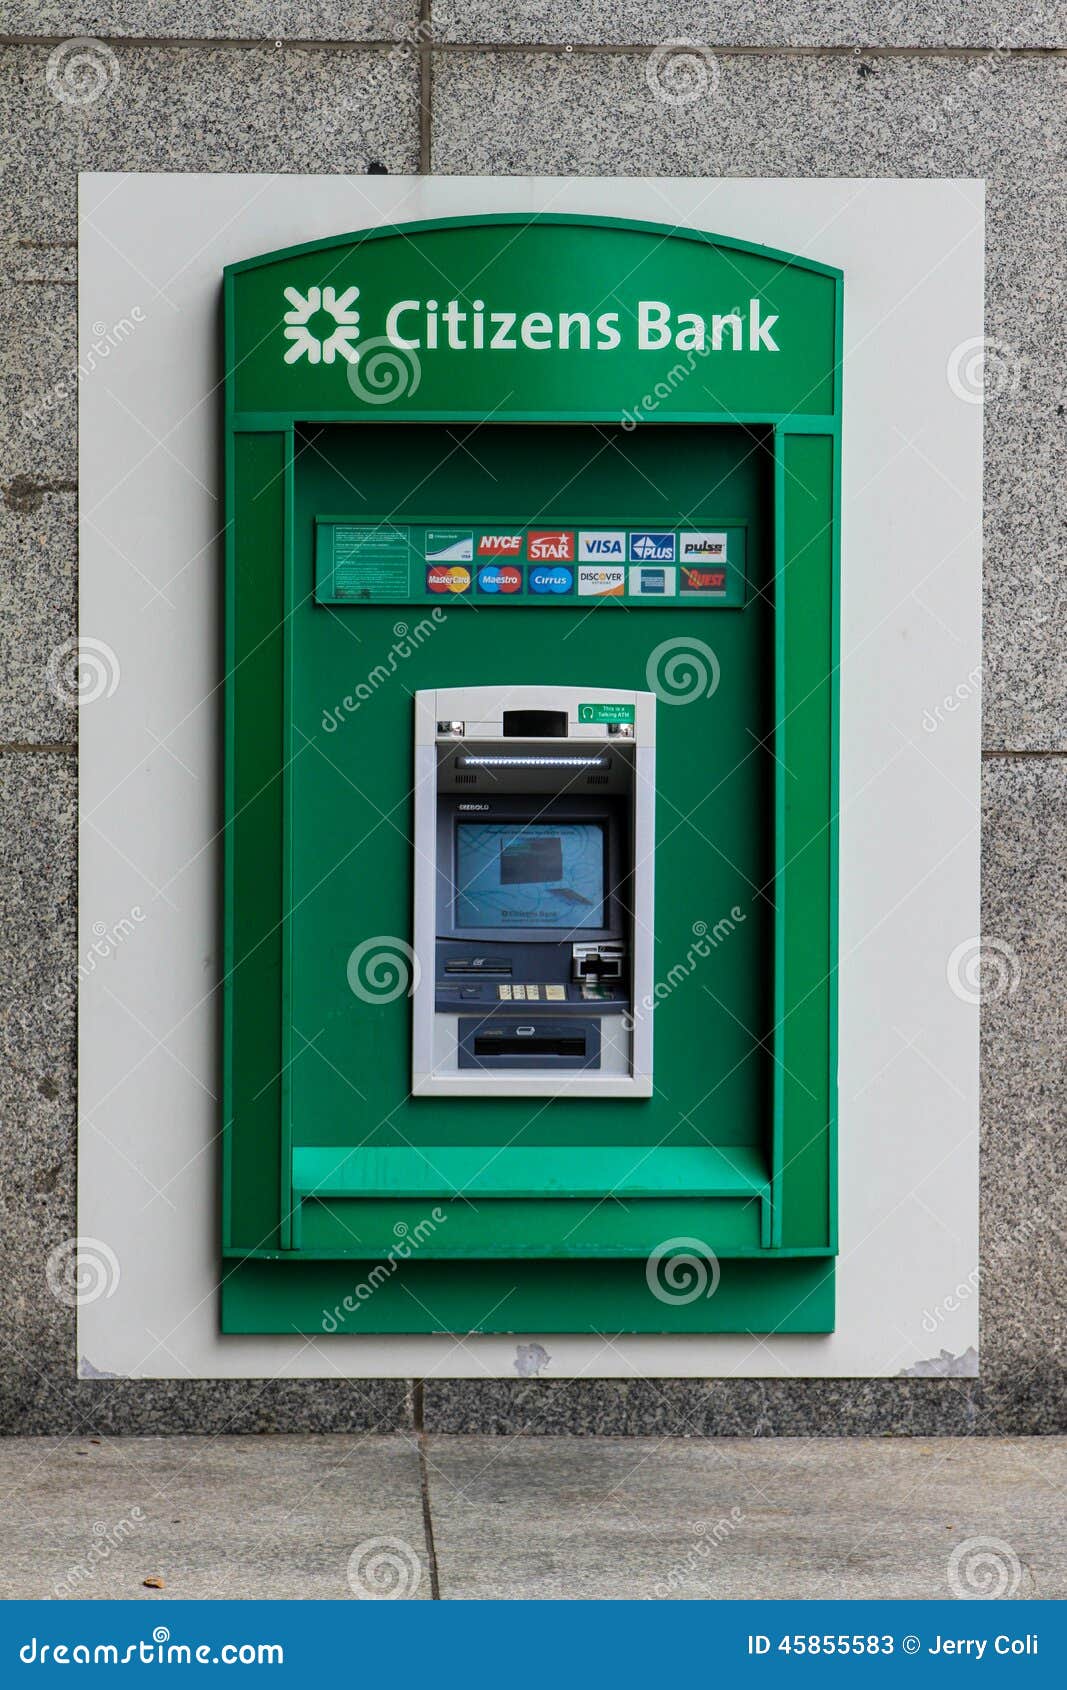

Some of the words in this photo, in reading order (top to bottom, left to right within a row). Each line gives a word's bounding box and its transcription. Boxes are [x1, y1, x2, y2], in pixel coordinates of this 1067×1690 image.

[386, 300, 622, 350] Citizens
[638, 299, 781, 352] Bank
[480, 536, 521, 549] NYCE
[585, 540, 622, 553] VISA
[530, 544, 570, 558] STAR
[643, 547, 673, 559] PLUS
[428, 575, 470, 585] MasterCard
[482, 576, 518, 584] Maestro
[534, 576, 567, 584] Cirrus
[580, 572, 622, 581] DISCOVER
